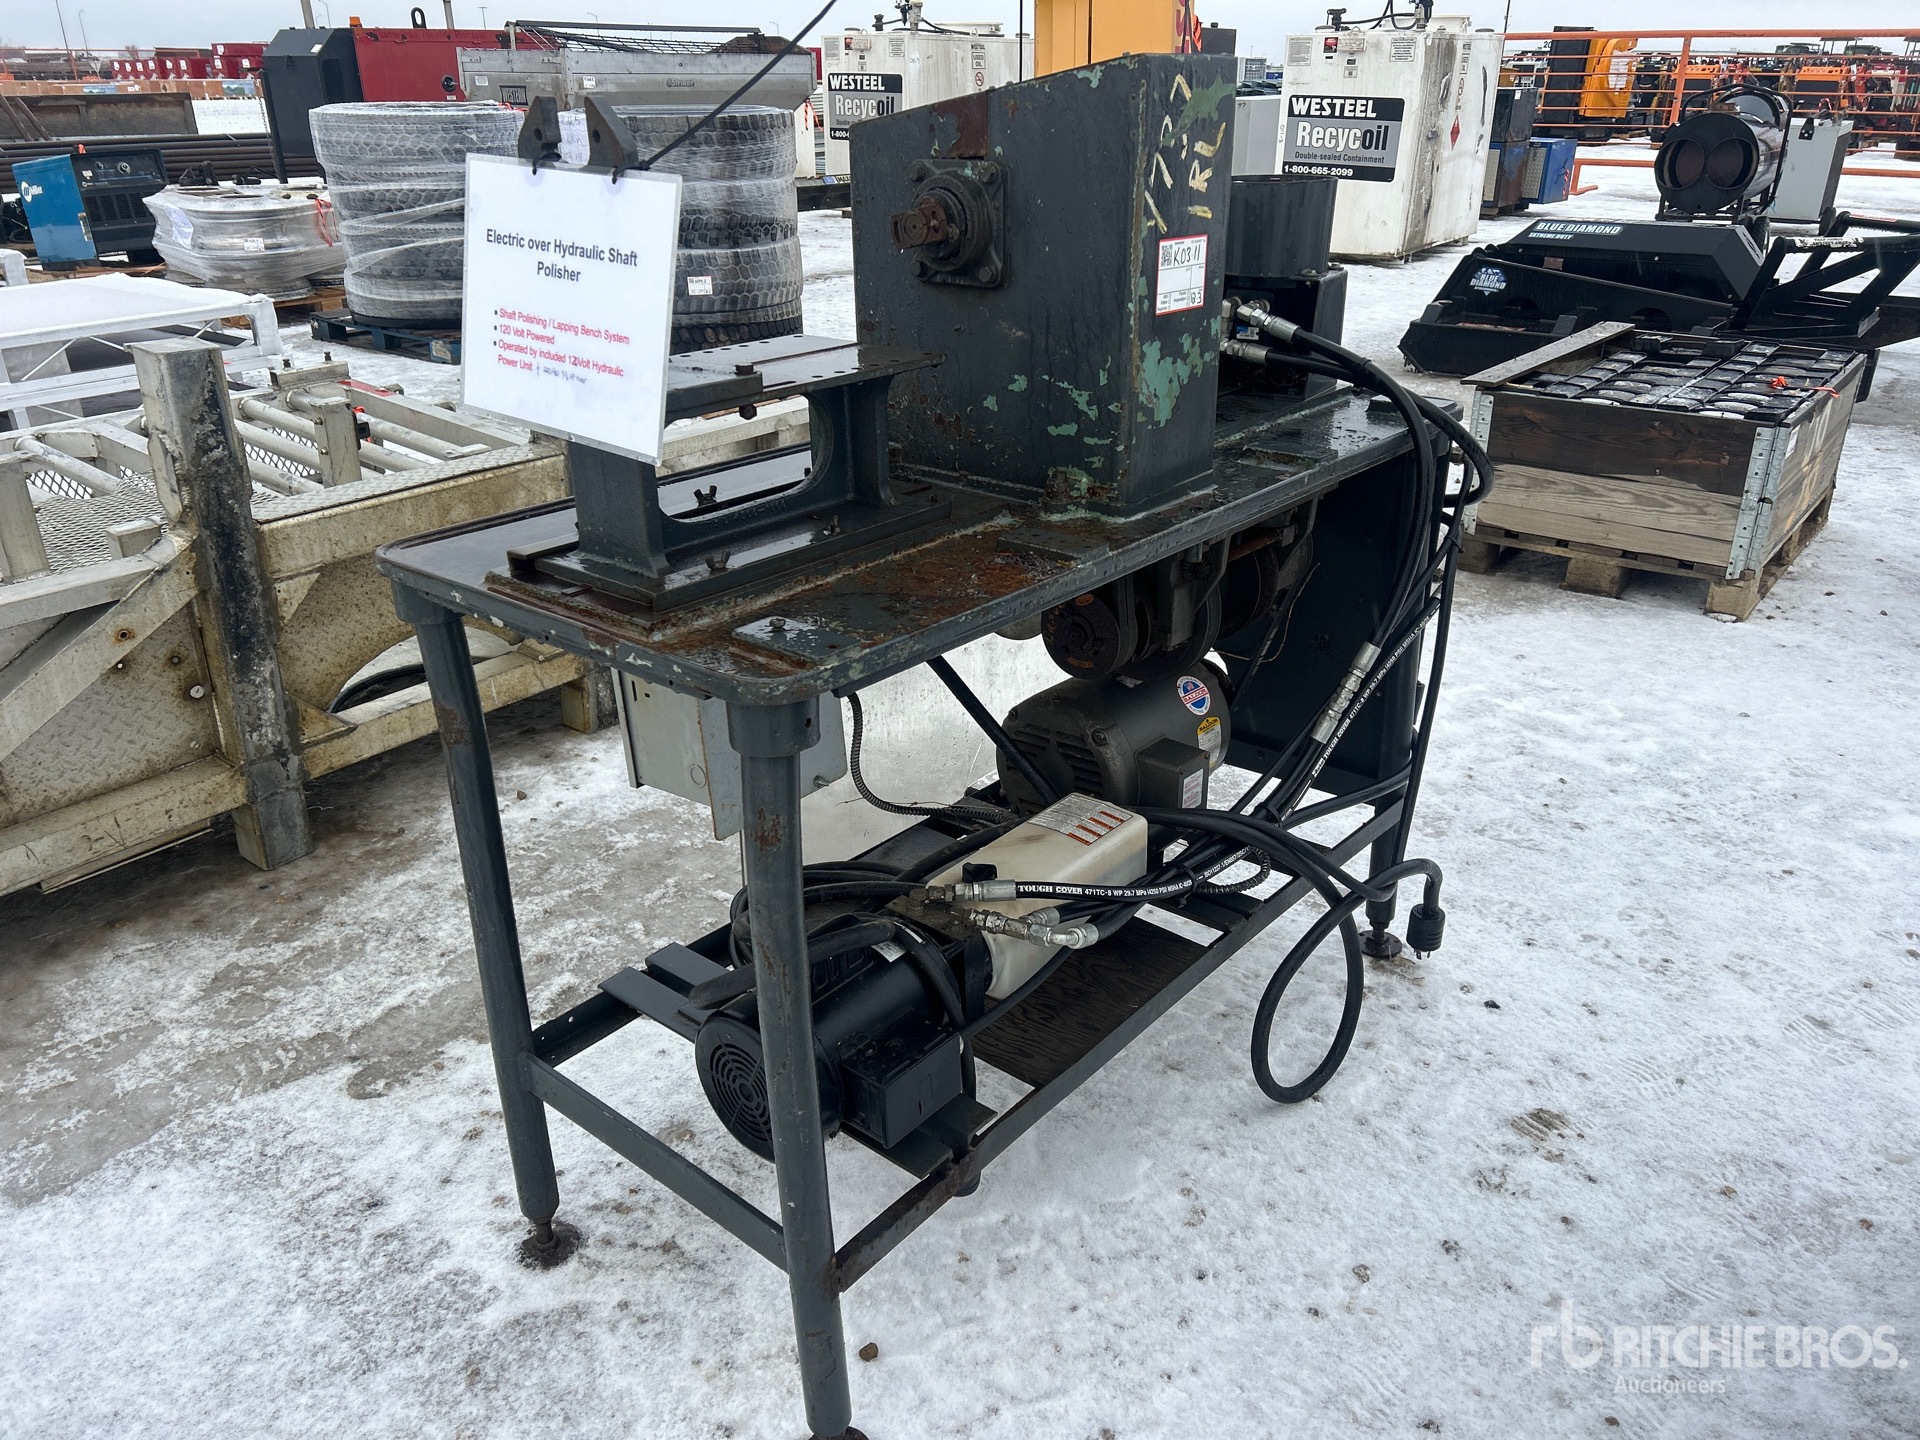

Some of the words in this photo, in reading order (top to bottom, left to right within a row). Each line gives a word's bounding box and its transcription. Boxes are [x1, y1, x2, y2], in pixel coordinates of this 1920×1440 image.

[829, 75, 885, 91] WESTEEL
[835, 94, 895, 117] Recycoil
[1291, 97, 1377, 118] WESTEEL
[1296, 121, 1390, 152] Recycoil
[1295, 151, 1342, 162] Double-sealed
[1343, 154, 1385, 164] Containment
[1284, 164, 1354, 177] 1-800-665-2099
[1536, 222, 1565, 231] BLUE
[1565, 224, 1622, 234] DIAMOND
[486, 228, 525, 248] Electric
[528, 238, 551, 252] over
[554, 238, 605, 262] Hydraulic
[608, 247, 638, 267] Shaft
[537, 261, 581, 282] Polisher
[1480, 273, 1499, 283] BLUE
[1470, 278, 1507, 290] DIAMOND
[499, 308, 516, 320] Shaft
[517, 311, 547, 329] Polishing
[552, 319, 579, 336] Lapping
[580, 324, 602, 339] Bench
[603, 329, 630, 345] System
[499, 324, 511, 335] 120
[512, 326, 525, 339] Volt
[526, 330, 555, 345] Powered
[497, 354, 518, 367] Power
[519, 359, 533, 372] Unit
[498, 339, 528, 354] Operated
[529, 346, 538, 359] by
[539, 348, 566, 363] included
[592, 358, 624, 377] Hydraulic
[1183, 688, 1207, 703] BALDOR
[1199, 718, 1219, 732] BALDOR
[1323, 737, 1338, 760] TOUGH
[1336, 718, 1351, 738] COVER
[1018, 885, 1053, 893] TOUGH
[1055, 886, 1083, 895] COVER
[1084, 888, 1112, 897] 471TC-8
[1113, 889, 1123, 897] WP
[1124, 888, 1135, 897] 29.7
[1135, 888, 1147, 896] MPa
